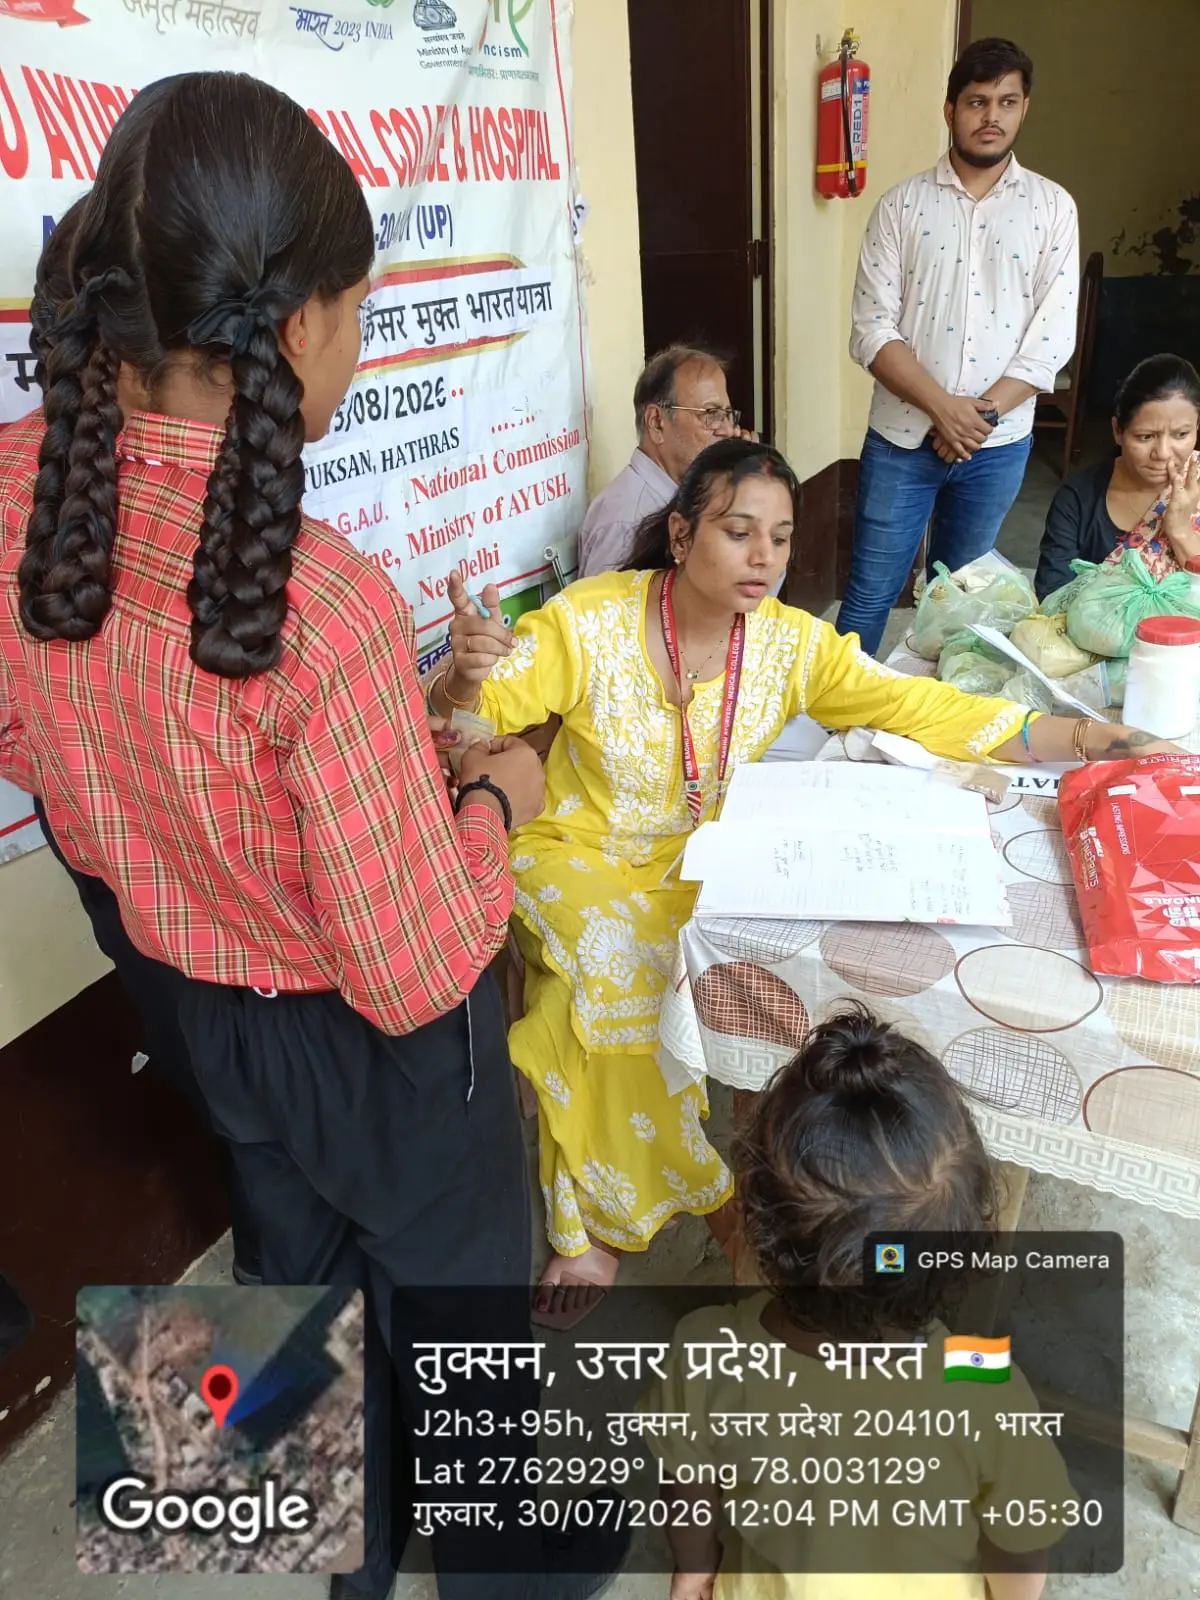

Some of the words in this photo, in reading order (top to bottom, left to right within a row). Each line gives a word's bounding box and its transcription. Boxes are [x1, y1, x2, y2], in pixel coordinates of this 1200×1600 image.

[334, 20, 361, 43] 2023
[365, 21, 394, 40] INDIA
[417, 46, 450, 57] Ministry
[451, 44, 459, 54] of
[484, 44, 522, 58] ncism
[451, 103, 468, 182] &
[468, 106, 560, 181] HOSPITAL
[416, 203, 453, 249] (UP)
[411, 297, 461, 346] मुक्त
[380, 426, 460, 473] HATHRAS
[409, 454, 488, 505] National
[492, 426, 580, 475] Commission
[406, 509, 477, 560] Ministry
[482, 496, 504, 525] of
[458, 542, 500, 584] Delhi
[731, 642, 739, 671] COLLEGE
[728, 673, 736, 700] MEDICAL
